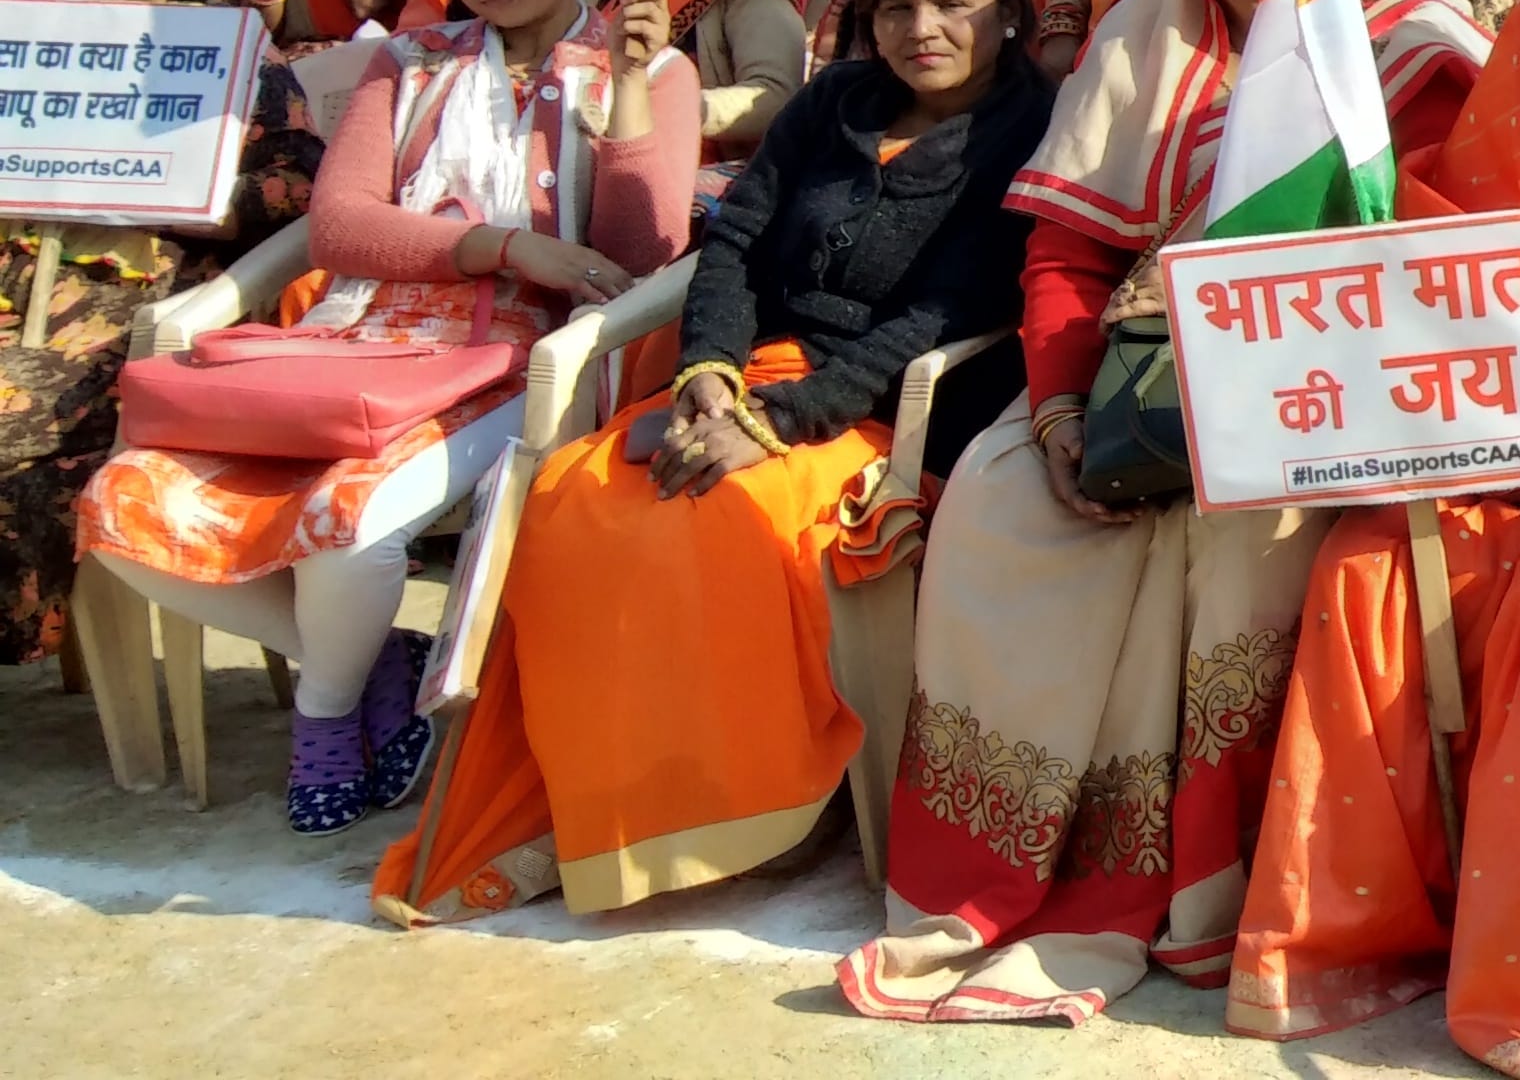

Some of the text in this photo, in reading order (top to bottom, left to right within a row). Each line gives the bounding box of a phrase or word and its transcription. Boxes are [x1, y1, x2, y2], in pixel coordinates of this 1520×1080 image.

[36, 41, 74, 69] का
[79, 42, 128, 71] क्या
[133, 32, 155, 73] है
[160, 45, 226, 79] काम,
[43, 91, 81, 119] का
[85, 82, 141, 121] रखो
[145, 94, 203, 122] मान
[1197, 262, 1384, 342] भारत
[1274, 346, 1518, 433] की जय
